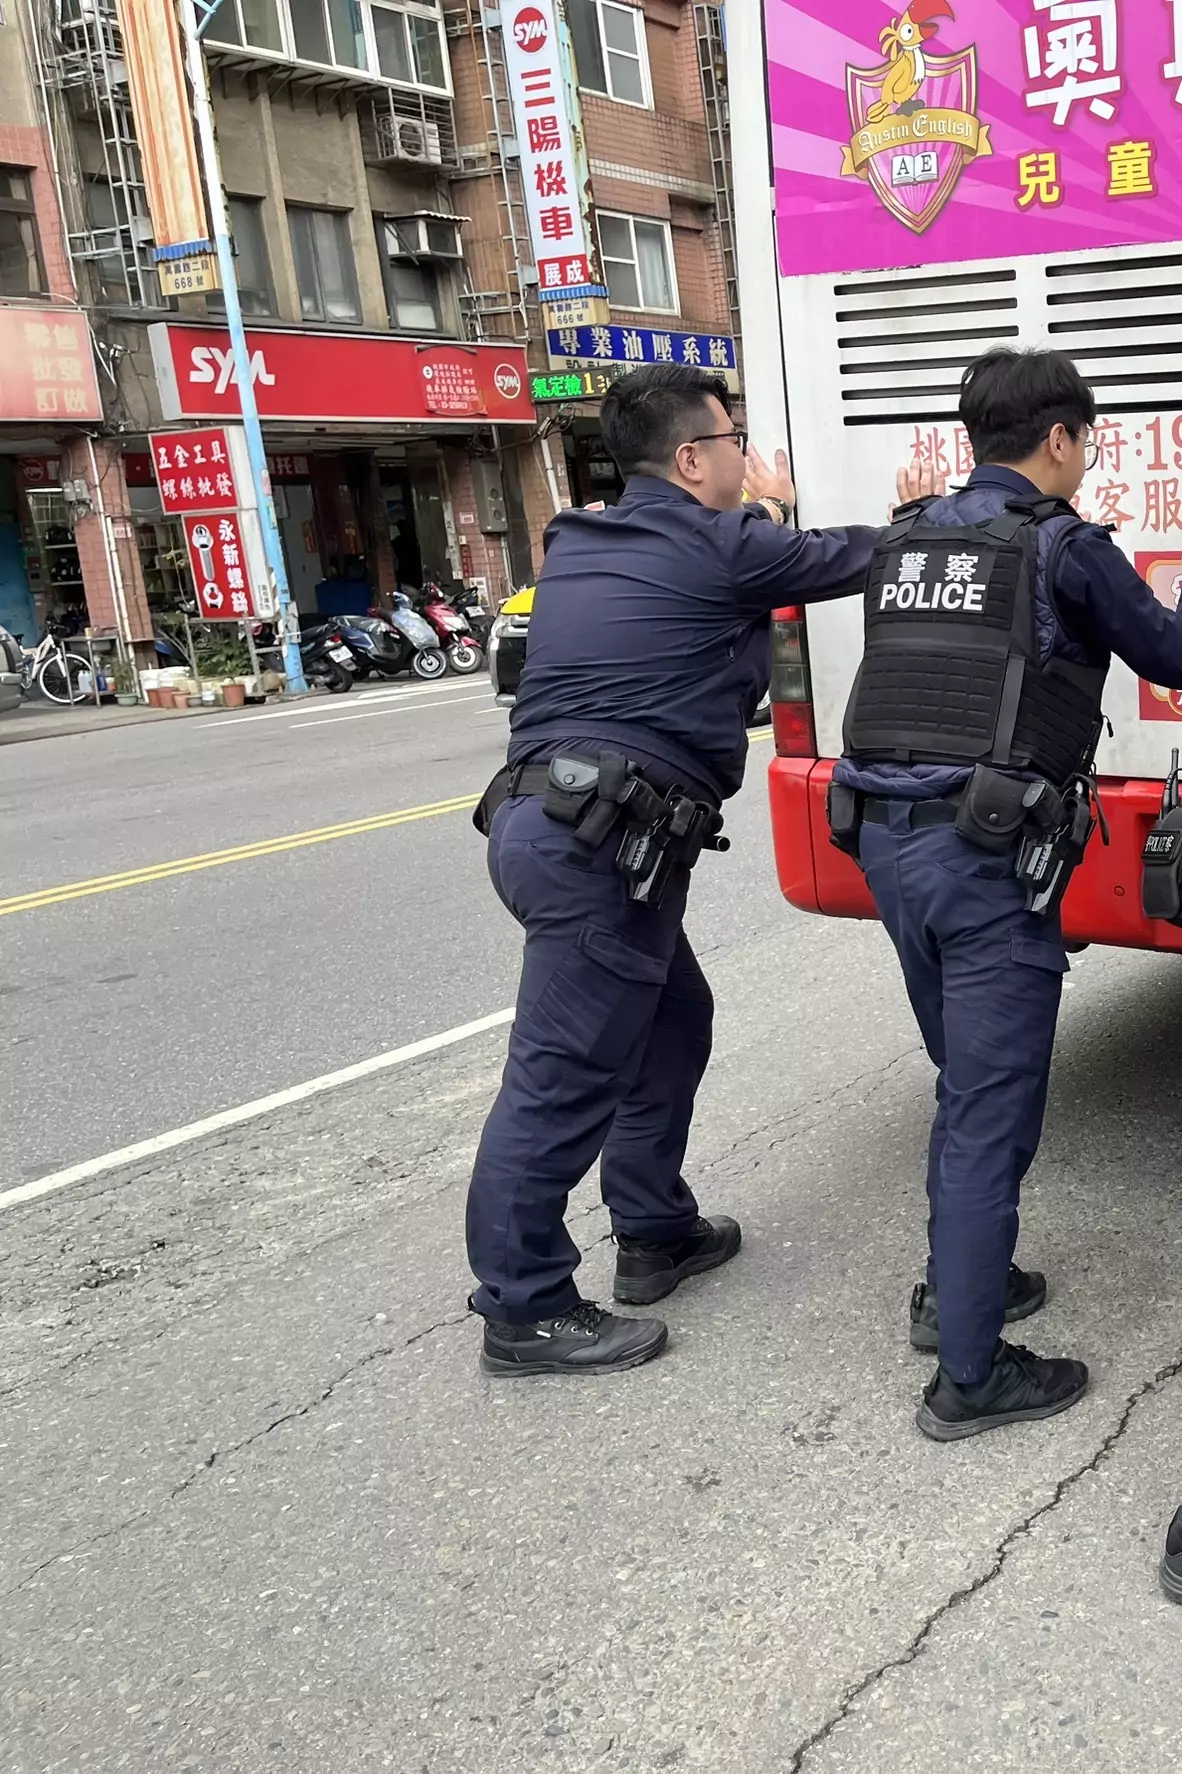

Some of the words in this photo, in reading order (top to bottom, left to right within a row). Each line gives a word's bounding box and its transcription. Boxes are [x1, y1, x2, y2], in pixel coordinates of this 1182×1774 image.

[514, 18, 548, 45] SYM
[858, 124, 909, 153] Austin
[912, 114, 973, 139] English
[521, 68, 574, 241] 三陽機車
[897, 157, 910, 175] A
[921, 154, 932, 172] E
[543, 260, 585, 286] 展成
[558, 327, 728, 367] 專業油壓系統
[189, 346, 275, 394] SYM
[496, 375, 520, 390] SYM
[158, 440, 226, 469] 五金工具
[162, 472, 232, 500] 螺絲批發
[219, 519, 248, 614] 永新螺絲
[898, 552, 979, 582] 警察
[880, 582, 986, 611] POLICE
